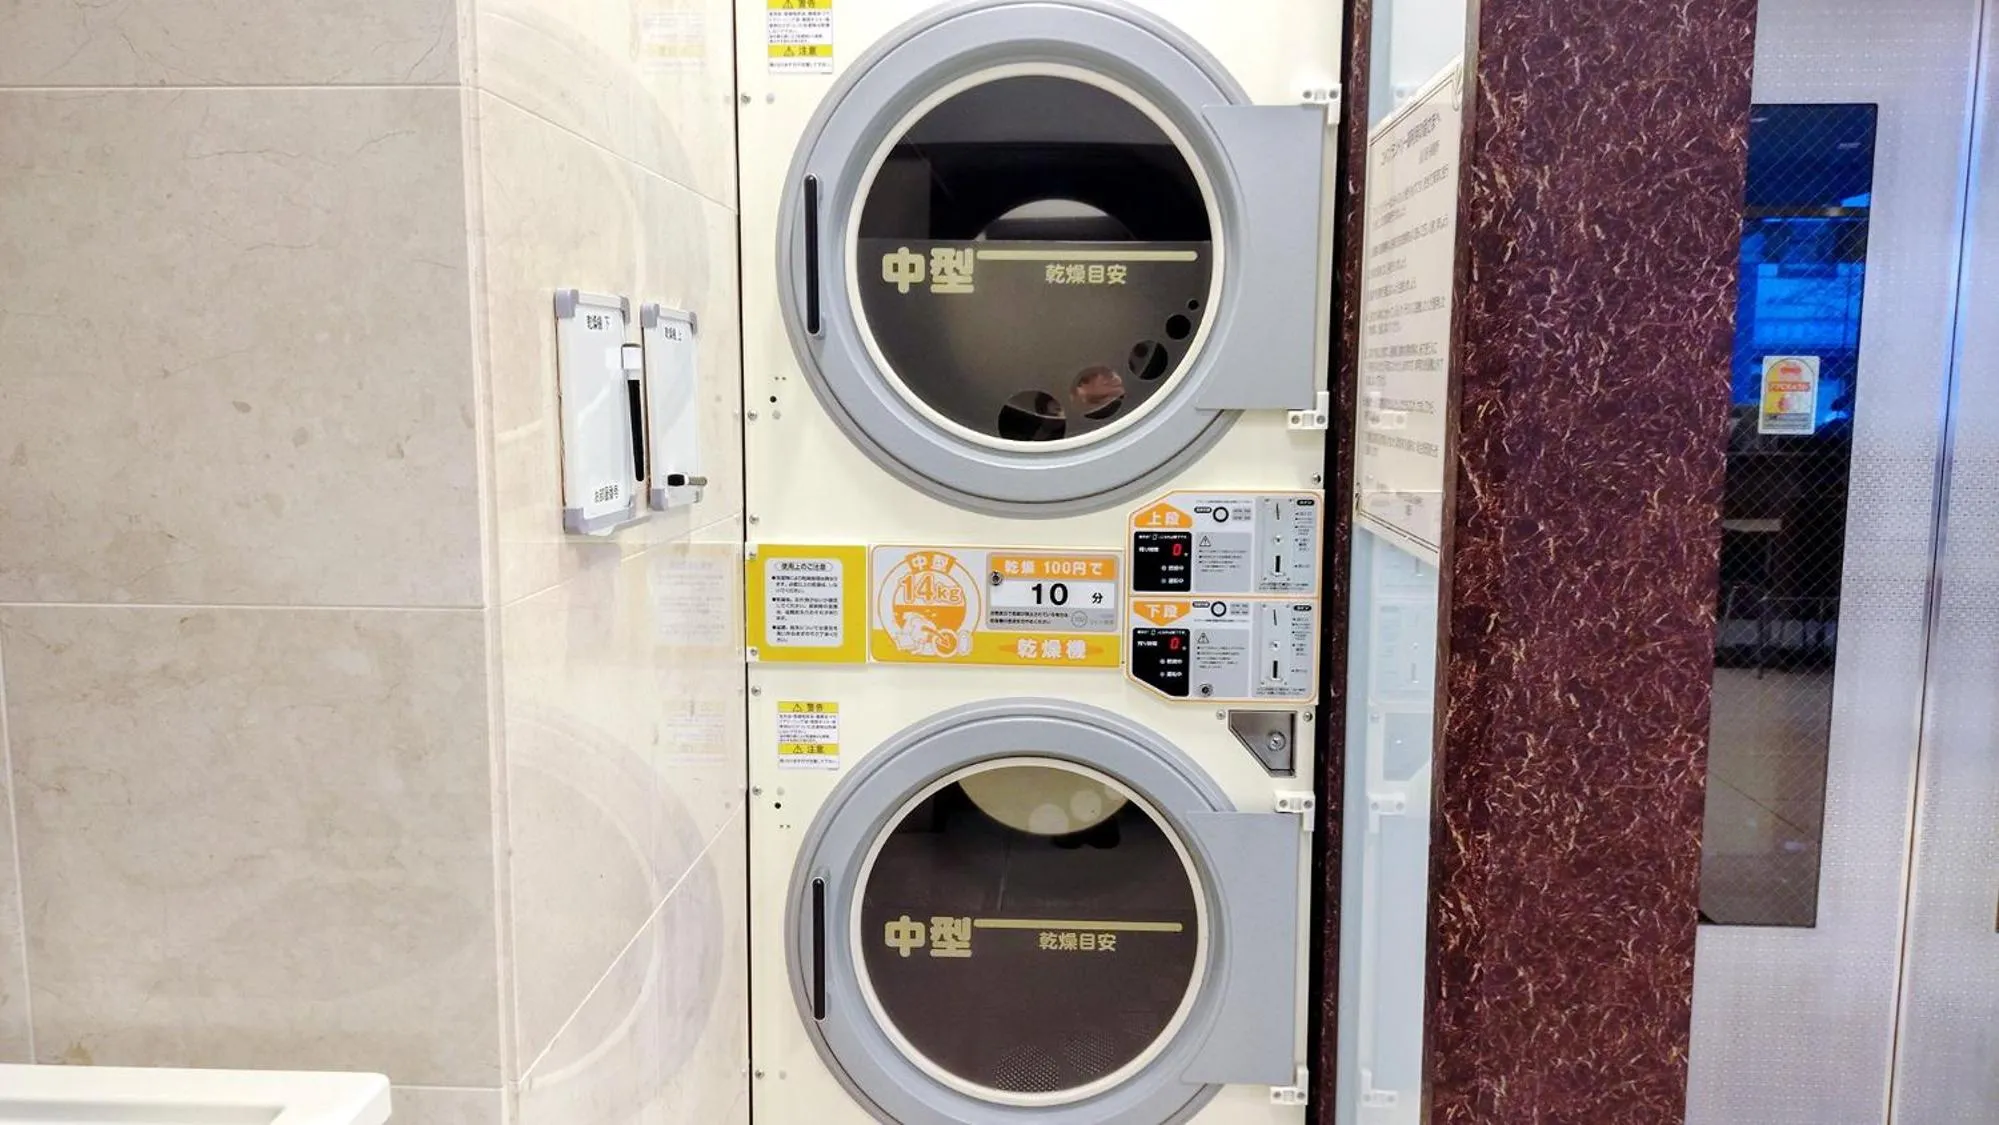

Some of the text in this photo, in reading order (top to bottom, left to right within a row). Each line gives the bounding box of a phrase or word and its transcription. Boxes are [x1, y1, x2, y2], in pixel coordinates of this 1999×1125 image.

[882, 247, 974, 293] 中型
[1045, 264, 1126, 285] 乾燥目安
[1147, 512, 1180, 526] 上段
[1172, 543, 1182, 556] 0
[781, 562, 826, 571] 使用上のご注意
[1004, 559, 1103, 576] 乾燥 100円で
[900, 574, 964, 605] 14kg
[1031, 583, 1103, 606] 10 分
[1144, 604, 1178, 619] 下段
[1017, 639, 1086, 660] 乾燥機
[1170, 637, 1180, 650] 0
[884, 915, 972, 957] 中型
[1039, 932, 1116, 952] 乾燥目安
